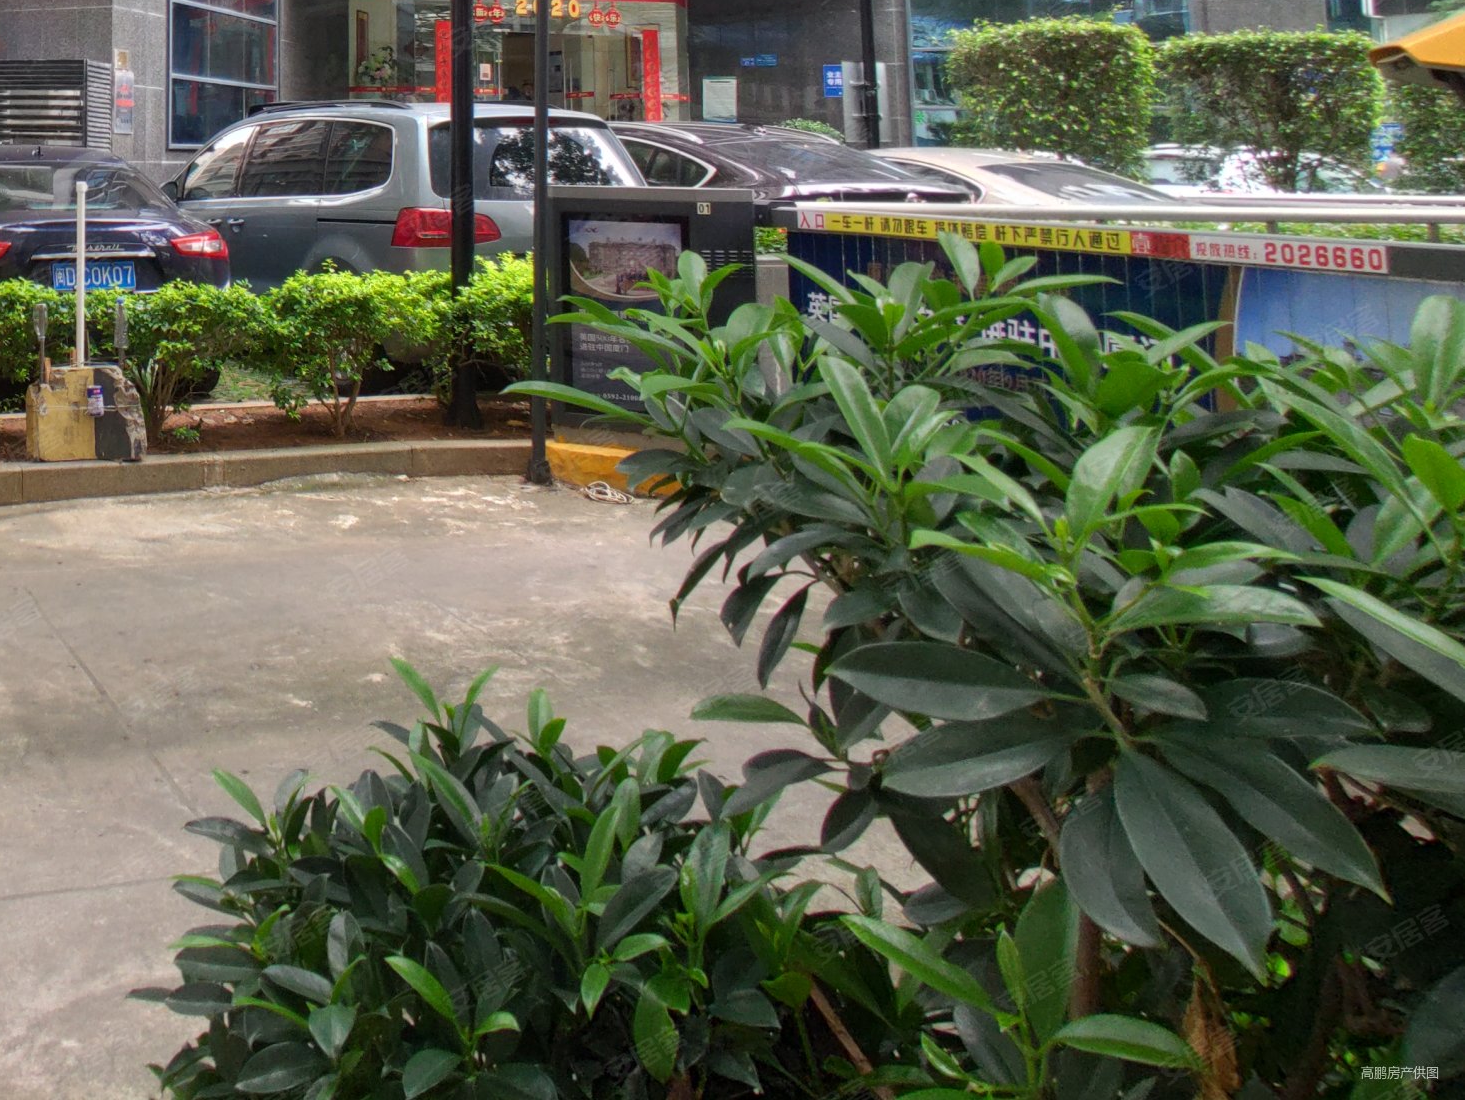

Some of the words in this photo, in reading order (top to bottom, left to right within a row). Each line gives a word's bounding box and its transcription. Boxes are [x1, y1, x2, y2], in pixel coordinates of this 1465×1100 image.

[698, 204, 711, 214] 01
[800, 212, 825, 229] 入口
[994, 224, 1121, 251] 杆下严禁行人通过
[1264, 241, 1384, 271] 2026660
